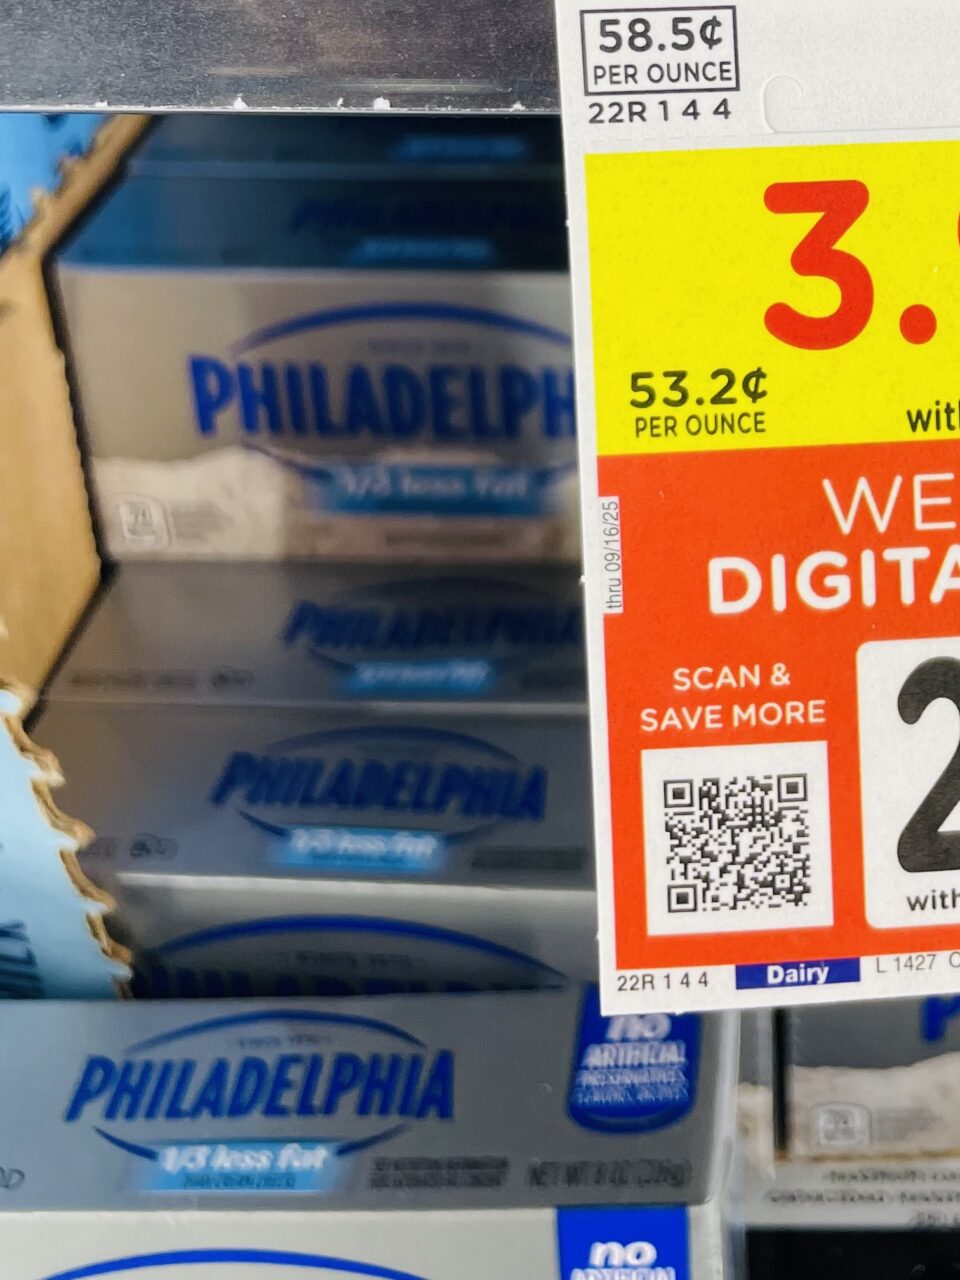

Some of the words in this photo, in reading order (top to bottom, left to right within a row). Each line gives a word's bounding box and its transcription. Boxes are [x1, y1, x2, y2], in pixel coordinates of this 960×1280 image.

[598, 14, 724, 55] 58.5¢
[593, 63, 639, 86] PER
[646, 61, 733, 85] OUNCE
[587, 100, 648, 125] 22R
[629, 366, 769, 410] 53.2¢
[634, 415, 678, 439] PER
[685, 411, 767, 437] OUNCE
[601, 500, 623, 573] 09/16/25
[604, 577, 624, 611] thru
[672, 664, 761, 692] SCAN
[769, 662, 791, 687] &
[640, 704, 724, 732] SAVE
[732, 699, 827, 728] MORE
[766, 962, 831, 986] Dairy
[875, 956, 886, 974] L
[893, 953, 937, 972] 1427
[616, 973, 656, 993] 22R
[64, 1048, 456, 1122] PHILADELPHIA
[588, 1240, 658, 1268] no
